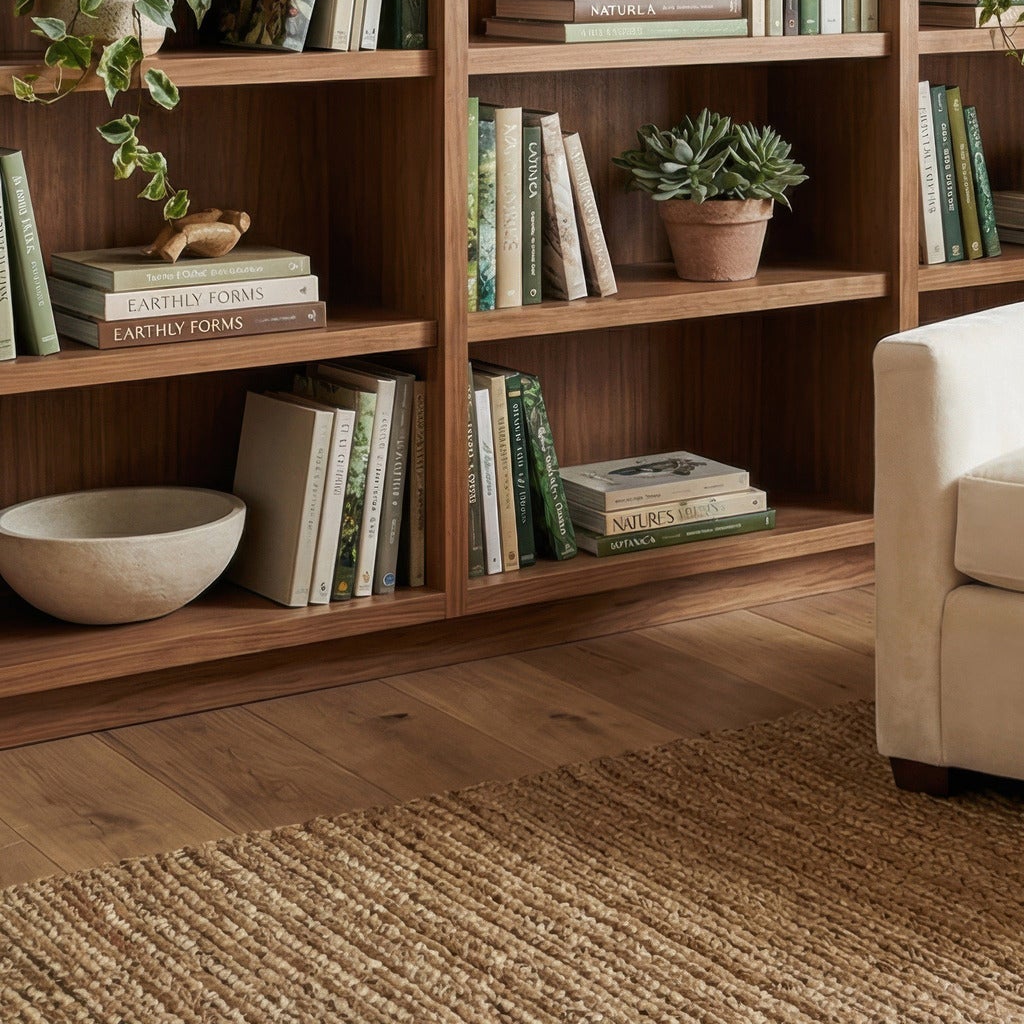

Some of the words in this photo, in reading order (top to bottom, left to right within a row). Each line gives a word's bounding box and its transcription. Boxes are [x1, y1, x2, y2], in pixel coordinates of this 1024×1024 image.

[128, 292, 202, 313] EARTHLY
[209, 287, 264, 304] FORMS
[114, 321, 185, 342] EARTHLY
[190, 316, 243, 334] FORMS
[613, 509, 675, 533] NATURES
